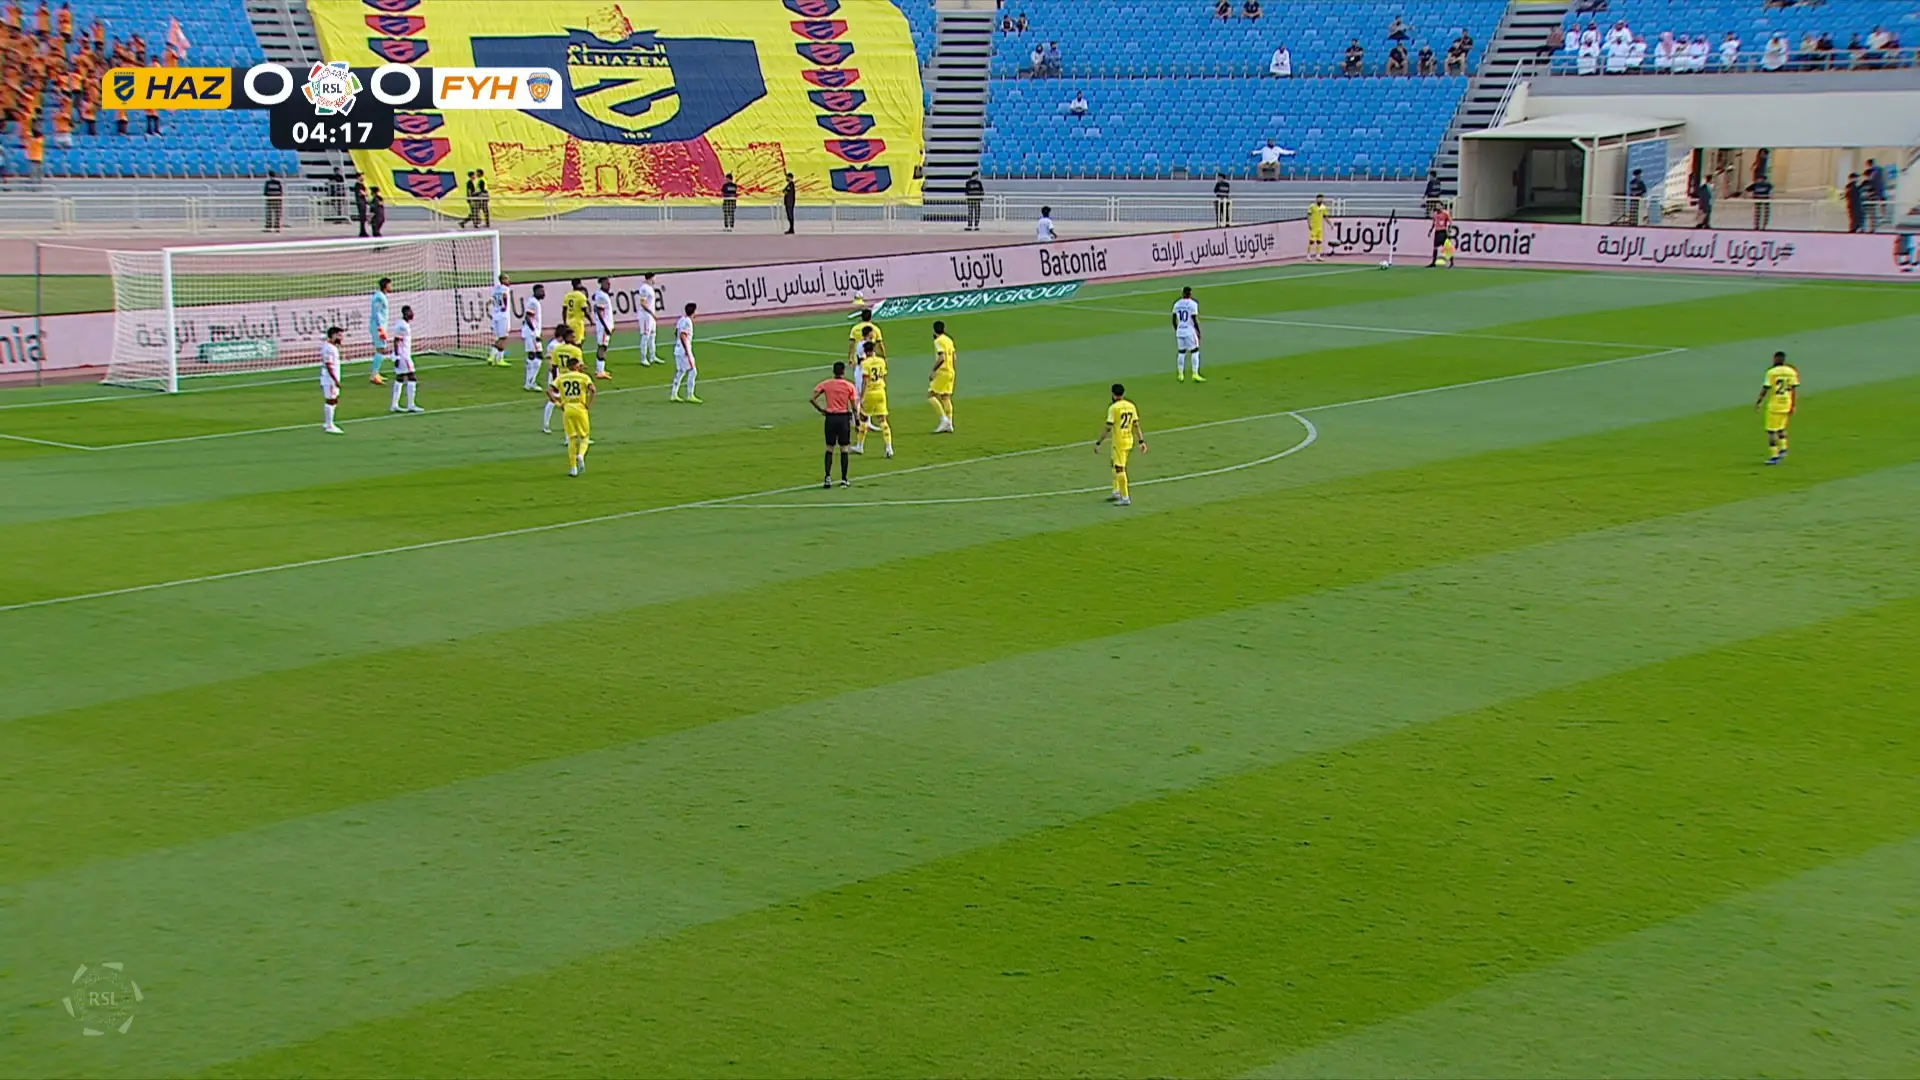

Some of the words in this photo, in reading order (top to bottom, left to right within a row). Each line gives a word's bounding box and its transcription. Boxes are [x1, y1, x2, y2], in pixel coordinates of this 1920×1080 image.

[567, 55, 670, 66] ALHAZEM
[1151, 233, 1274, 264] #باتونيا_أساس_الراحة
[1333, 219, 1399, 252] باتونيا
[1449, 225, 1532, 255] Batonia
[1597, 233, 1795, 267] #باتونيا_أساس_الراحة
[950, 254, 1003, 288] باتونيا
[1040, 248, 1107, 278] Batonia
[725, 266, 884, 304] #باتونيا_أساس_الراحة
[994, 282, 1077, 304] GROUP
[567, 299, 575, 311] 9
[1178, 310, 1189, 322] 10
[563, 381, 581, 396] 28
[1120, 412, 1132, 429] 27
